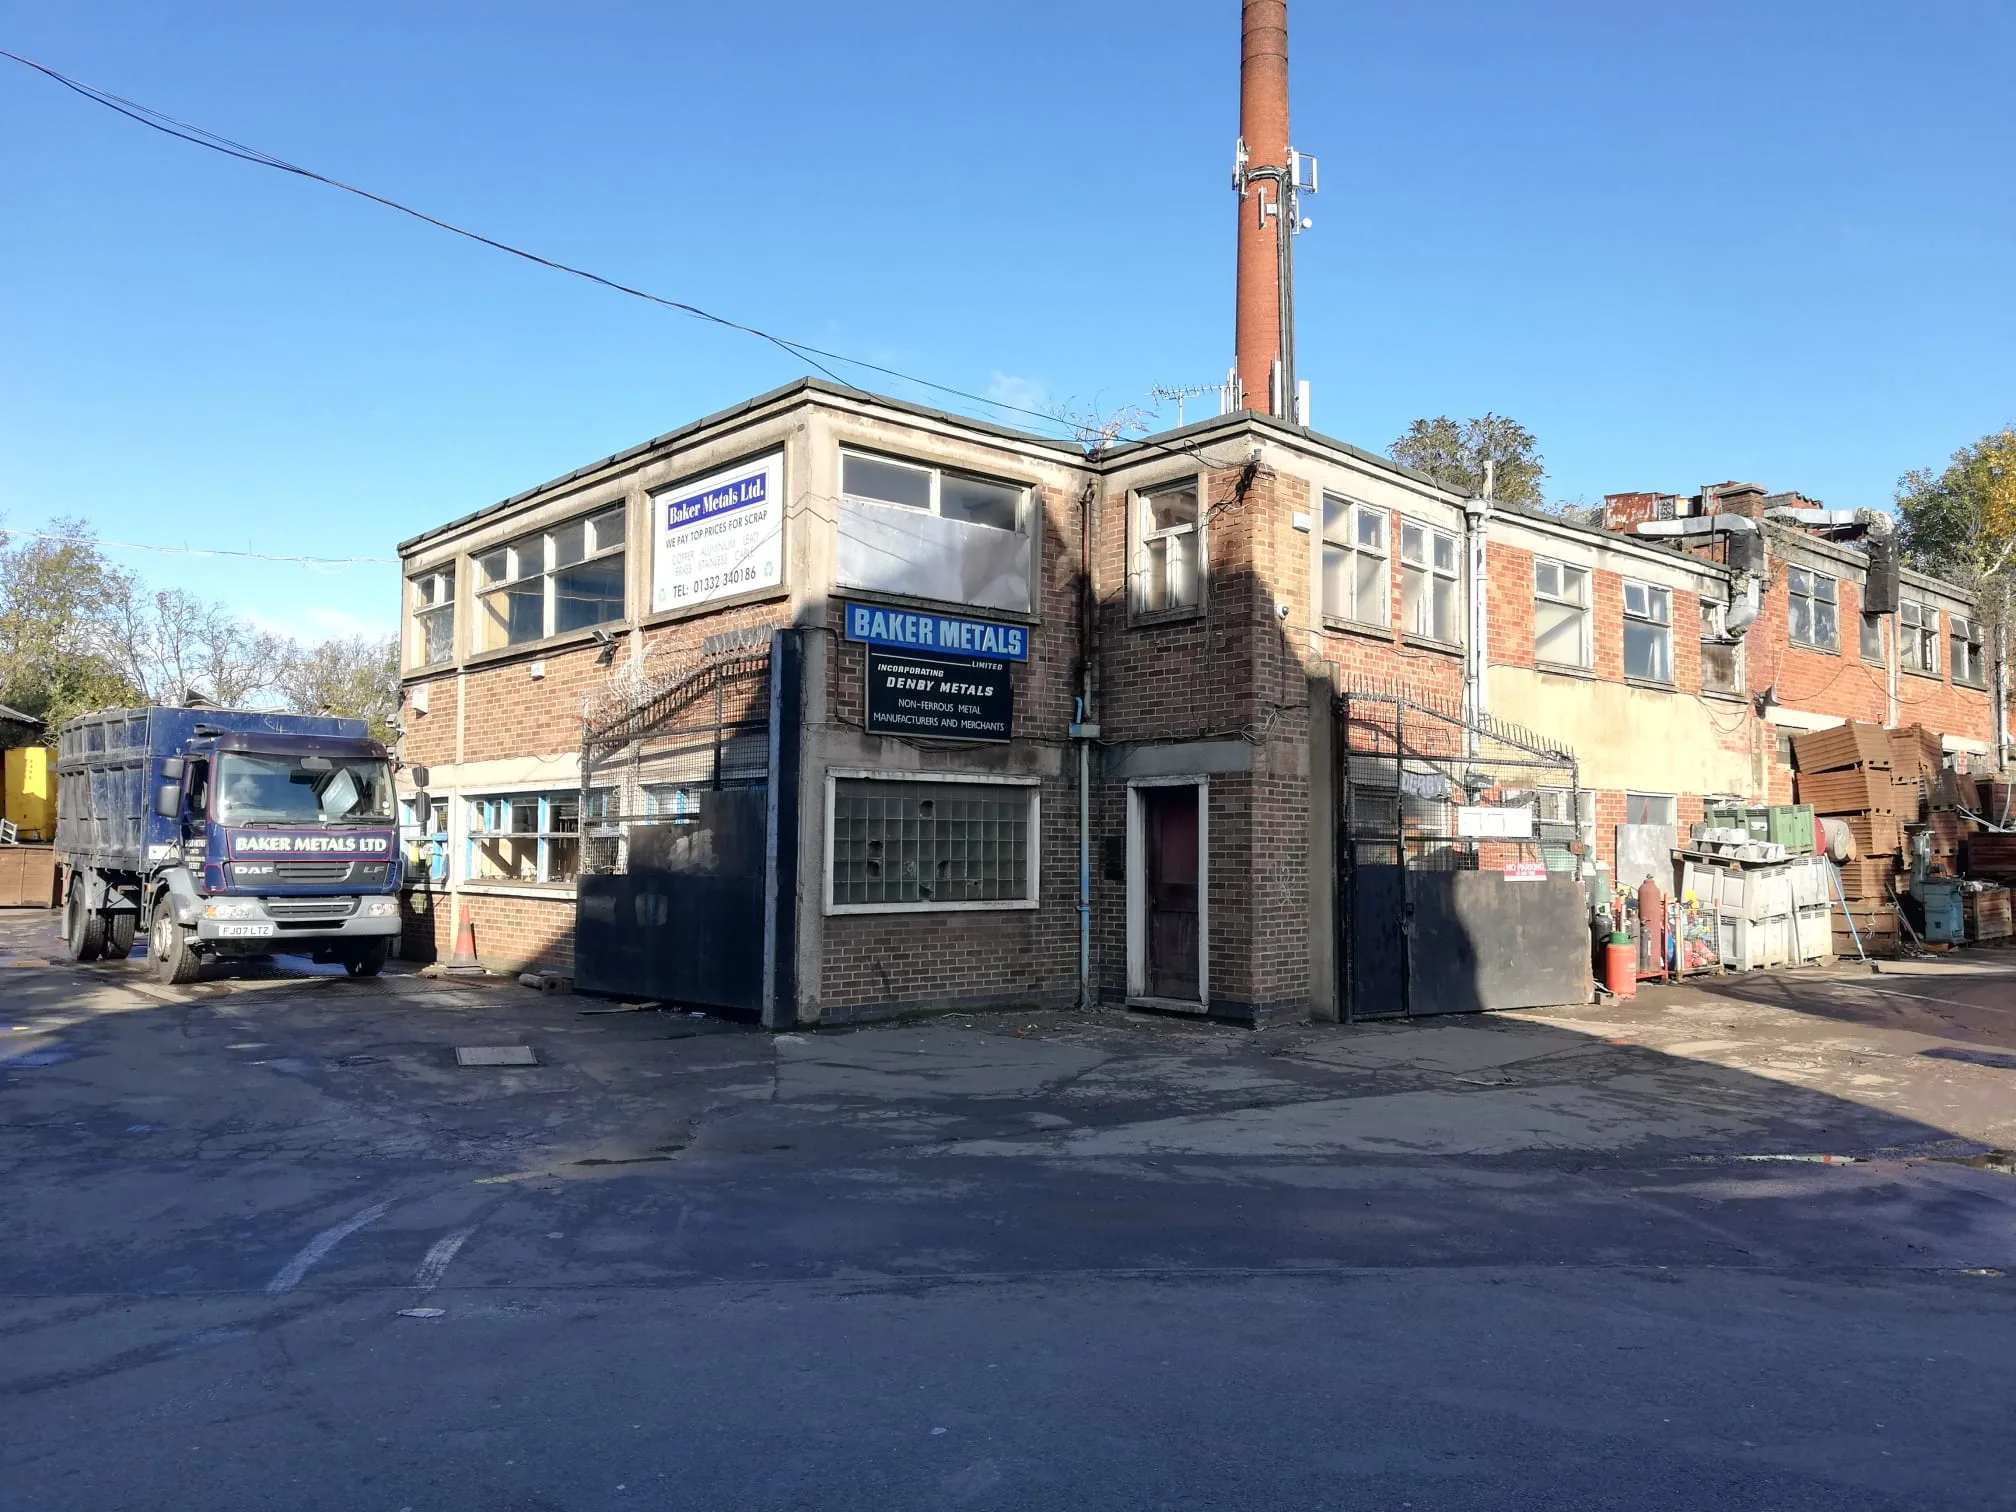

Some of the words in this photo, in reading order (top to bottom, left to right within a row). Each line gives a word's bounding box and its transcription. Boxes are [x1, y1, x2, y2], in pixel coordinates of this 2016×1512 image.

[669, 503, 701, 525] Baker
[702, 488, 738, 515] Metals
[740, 478, 764, 502] Ltd.
[665, 536, 676, 549] WE
[677, 533, 688, 547] PAY
[690, 528, 703, 543] TOP
[704, 521, 727, 539] PRICES
[728, 517, 743, 532] FOR
[744, 510, 768, 526] SCRAP
[673, 583, 689, 598] TEL:
[693, 574, 720, 594] 01332
[722, 566, 756, 587] 340186
[854, 608, 933, 645] BAKER
[939, 620, 1021, 656] METALS
[877, 663, 944, 678] INCORPORATING
[972, 661, 1003, 671] LIMITED
[886, 676, 935, 692] DENBY
[939, 682, 994, 697] METALS
[898, 698, 954, 712] NON-FERROUS
[958, 704, 981, 715] METAL
[873, 712, 939, 727] MANUFACTURERS
[941, 718, 958, 728] AND
[960, 720, 1005, 732] MERCHANTS
[235, 837, 291, 851] BAKER
[294, 838, 357, 852] METALS
[359, 838, 387, 852] LTD
[234, 866, 274, 874] DAF
[222, 927, 248, 936] FJ07
[251, 927, 270, 935] LTZ
